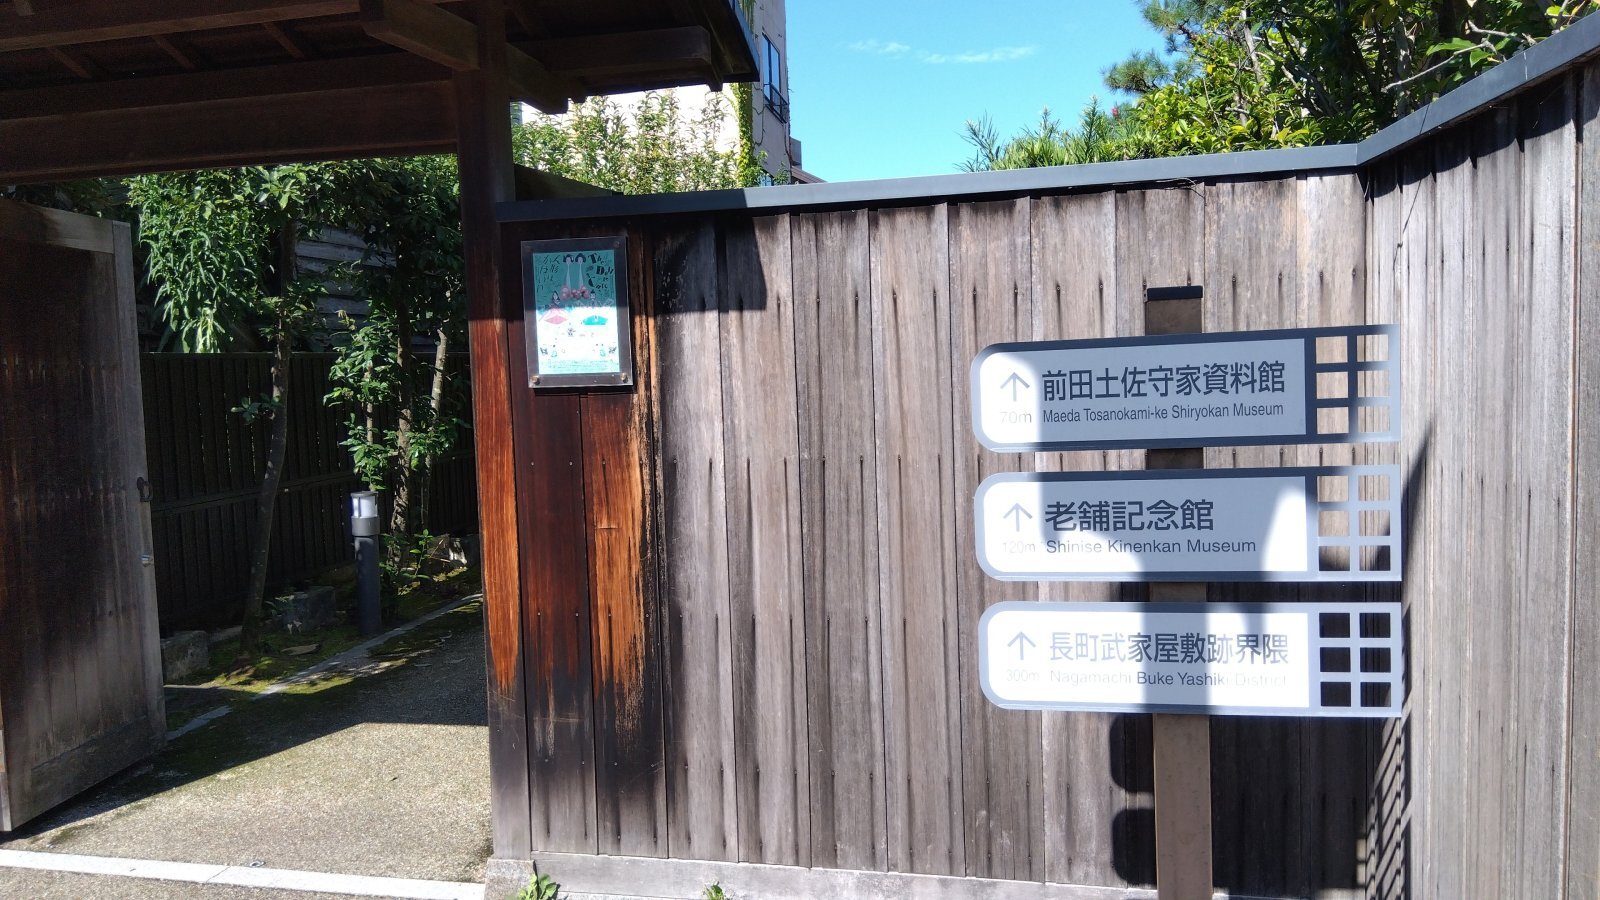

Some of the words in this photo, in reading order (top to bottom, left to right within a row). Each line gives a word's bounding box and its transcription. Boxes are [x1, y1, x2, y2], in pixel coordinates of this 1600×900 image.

[1042, 360, 1286, 402] 前田土佐守家資料館
[1000, 410, 1032, 424] 70m
[1042, 408, 1081, 424] Maeda
[1083, 405, 1168, 422] Tosanokami-ke
[1171, 404, 1230, 423] Shiryokan
[1233, 402, 1284, 418] Museum
[1045, 499, 1214, 532] 老舗記念館
[1002, 540, 1036, 554] 120m
[1046, 539, 1102, 554] Shinise
[1108, 539, 1181, 554] Kinenkan
[1187, 539, 1256, 553] Museum
[1049, 632, 1288, 665] 長町武家屋敷跡界隈
[1006, 669, 1039, 682] 300m
[1050, 670, 1131, 688] Nagamachi
[1137, 671, 1174, 685] Buke
[1177, 671, 1229, 686] Yashiki
[1235, 672, 1286, 687] District
